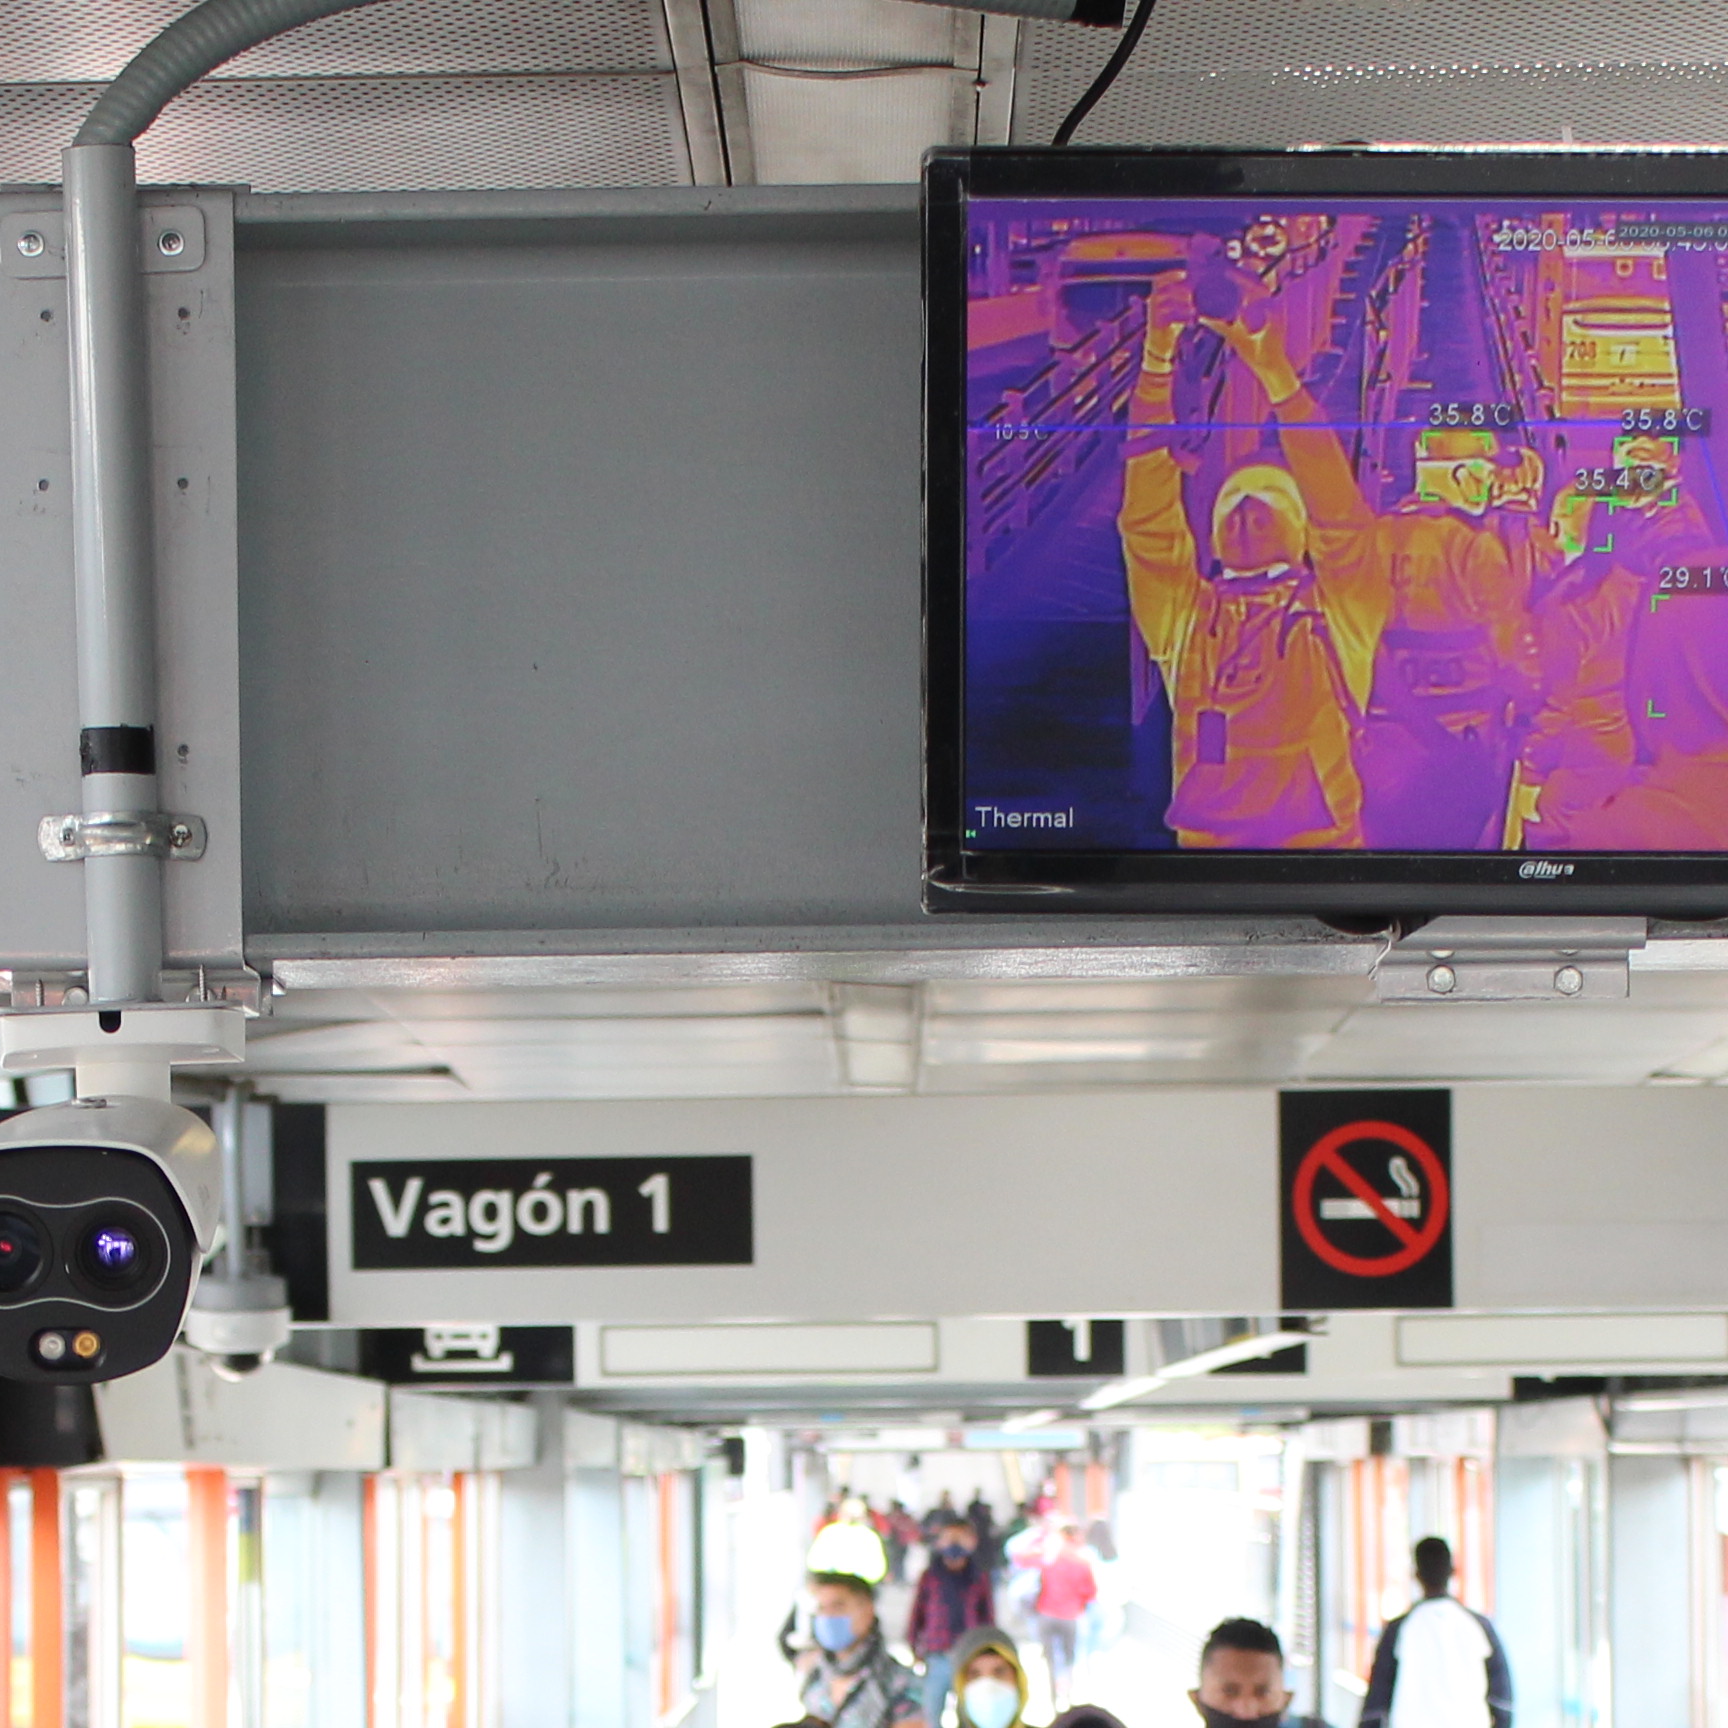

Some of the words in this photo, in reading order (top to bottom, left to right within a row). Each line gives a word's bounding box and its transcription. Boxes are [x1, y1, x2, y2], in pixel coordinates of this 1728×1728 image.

[1619, 226, 1713, 238] 2020-05-06
[974, 806, 1074, 828] Thermal
[367, 1171, 611, 1254] Vagón
[637, 1172, 671, 1235] 1
